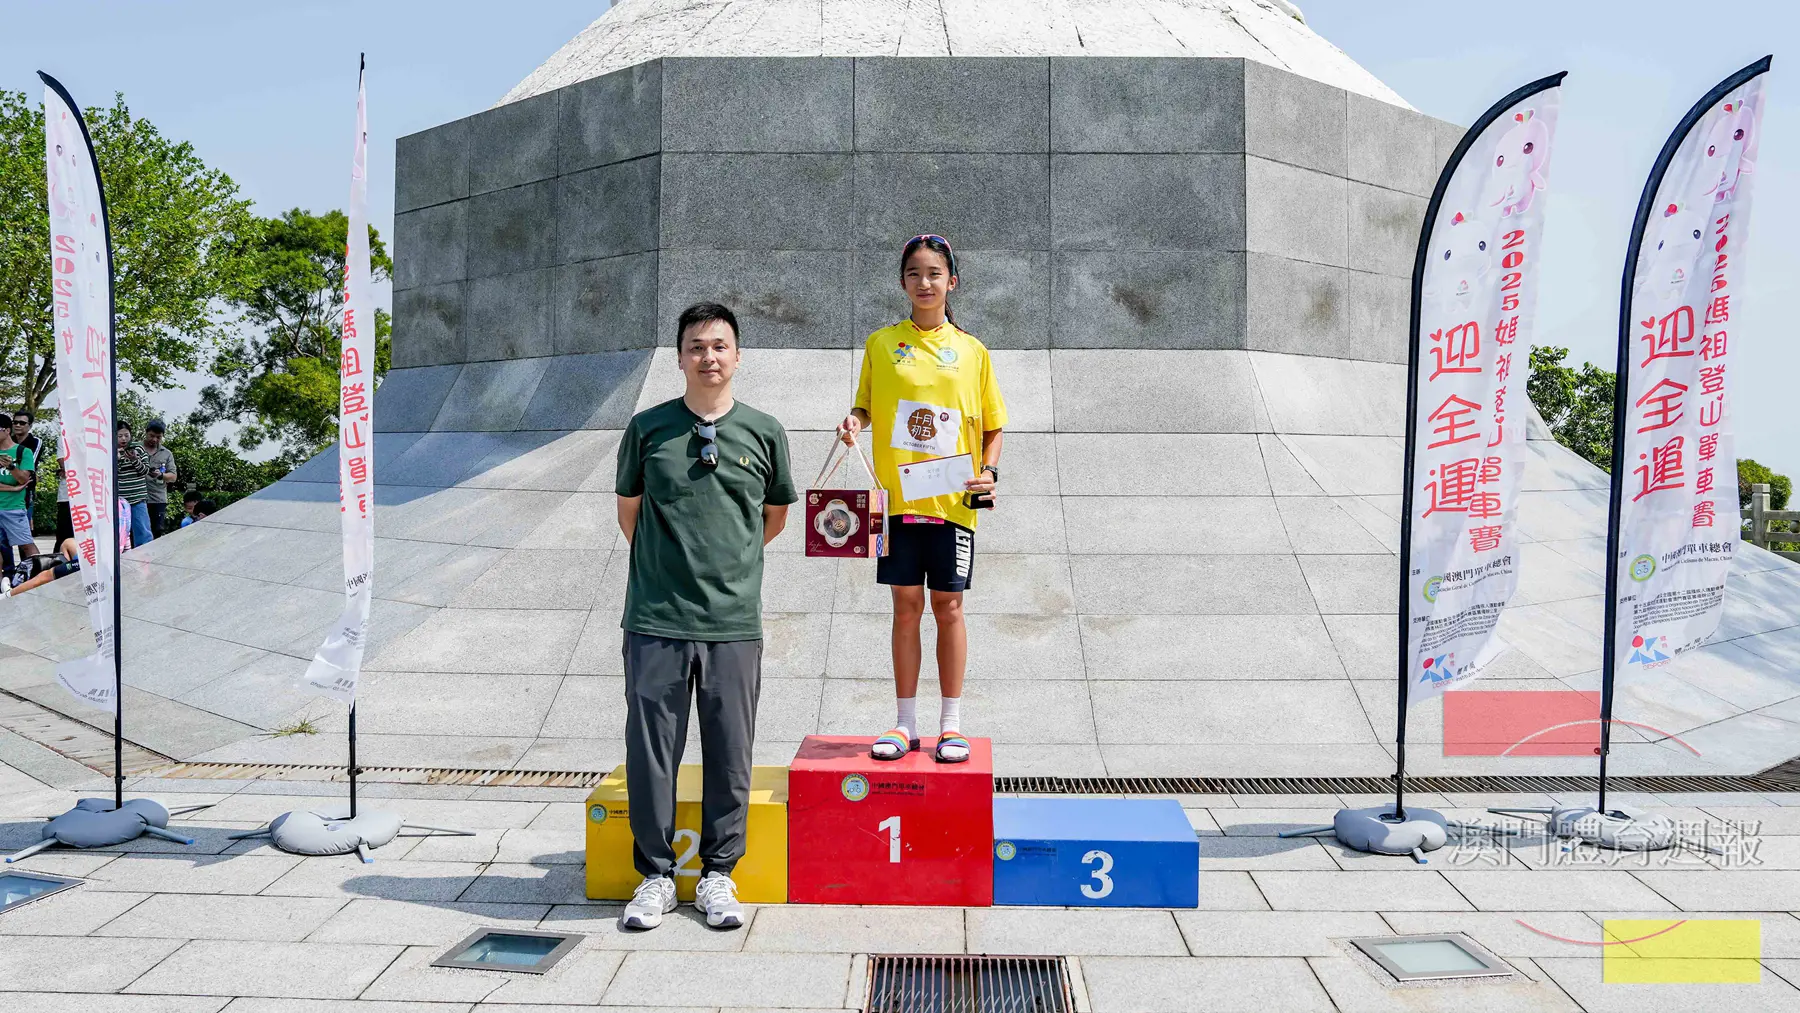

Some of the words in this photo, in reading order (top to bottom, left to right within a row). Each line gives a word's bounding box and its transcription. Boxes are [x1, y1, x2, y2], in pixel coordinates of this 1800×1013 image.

[912, 411, 933, 426] 十月
[1422, 321, 1482, 519] 迎全運
[1632, 305, 1695, 502] 迎全運
[903, 440, 923, 449] OCTOBER
[922, 443, 936, 451] FIFTH
[911, 424, 932, 439] 初五
[955, 527, 971, 578] OAKLEY
[672, 828, 701, 876] 2
[878, 816, 901, 863] 1
[1080, 849, 1114, 899] 3
